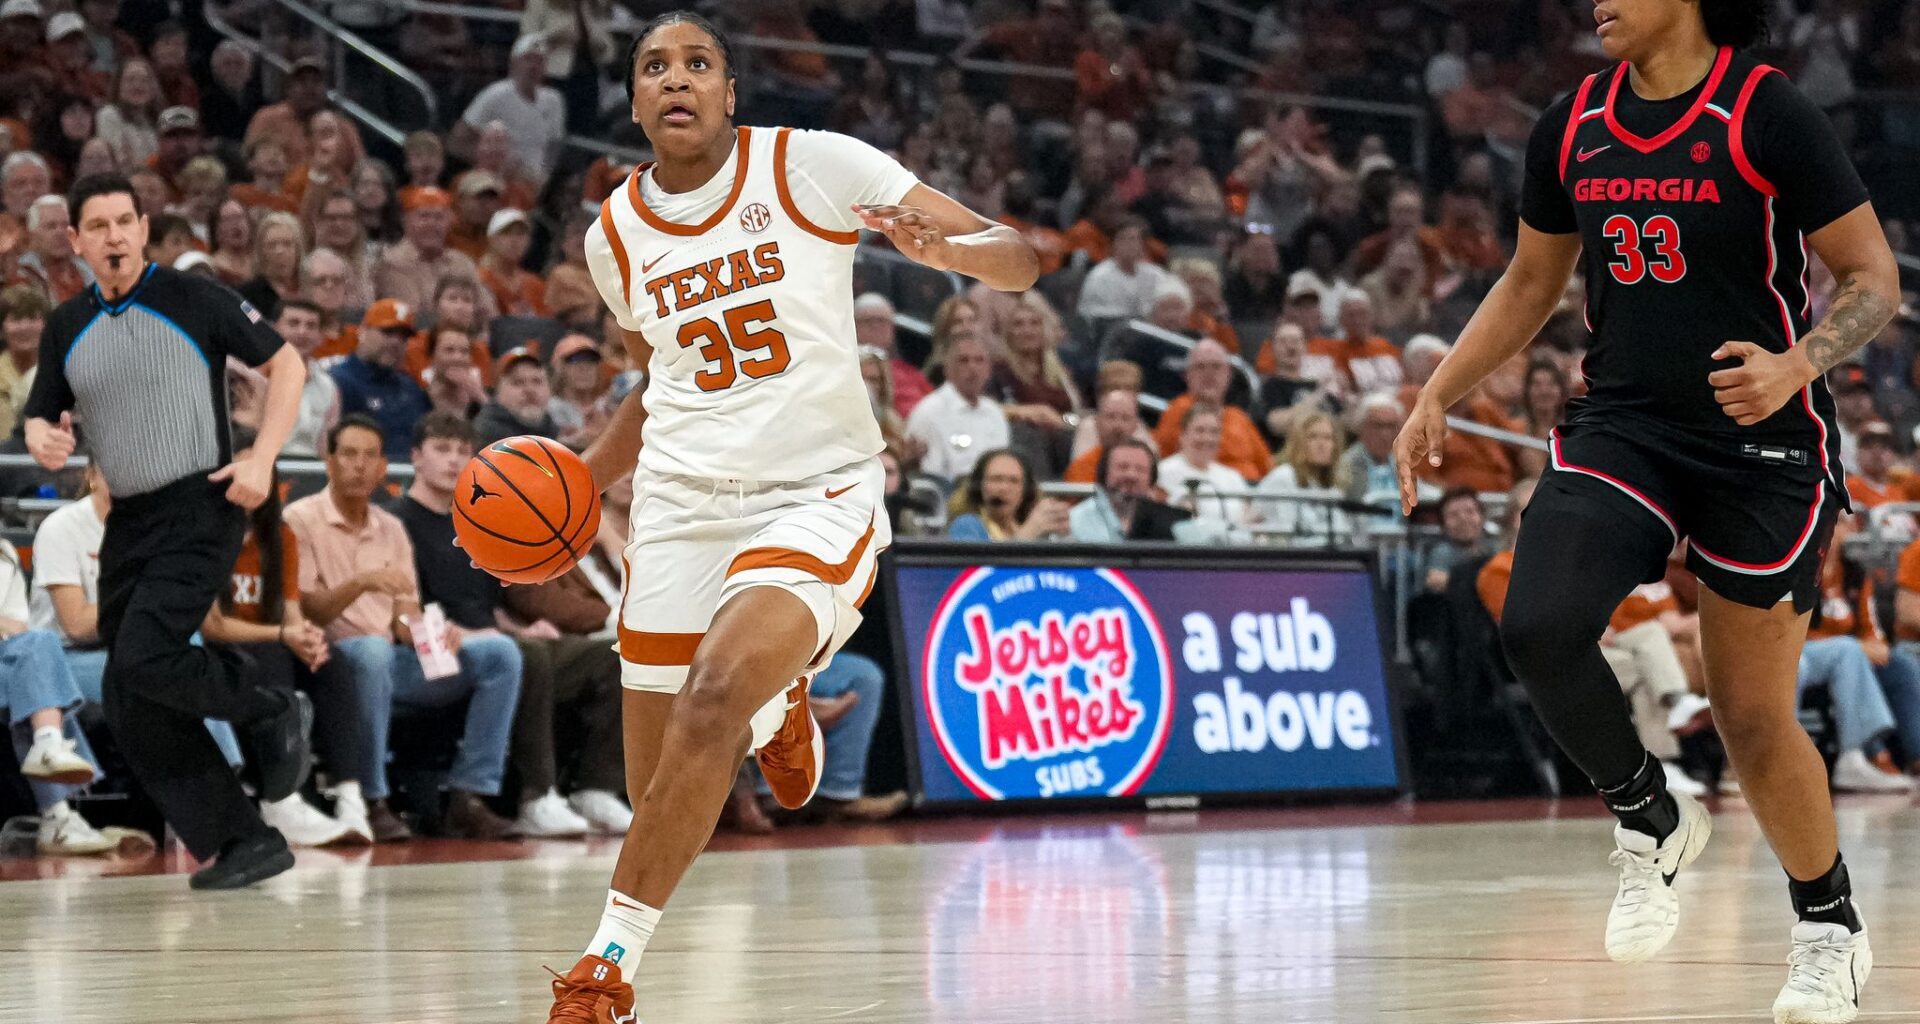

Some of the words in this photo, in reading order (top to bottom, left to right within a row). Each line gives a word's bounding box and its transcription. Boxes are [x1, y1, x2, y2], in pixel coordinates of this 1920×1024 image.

[740, 203, 770, 232] SEC
[1574, 177, 1721, 203] GEORGIA
[645, 241, 785, 319] TEXAS
[1602, 214, 1687, 285] 33
[676, 299, 791, 392] 35
[1789, 449, 1800, 459] 48
[959, 611, 1131, 686] Jersey
[1182, 611, 1223, 673] a
[1230, 596, 1336, 673] sub
[981, 673, 1140, 764] Mike's
[1035, 755, 1104, 797] SUBS
